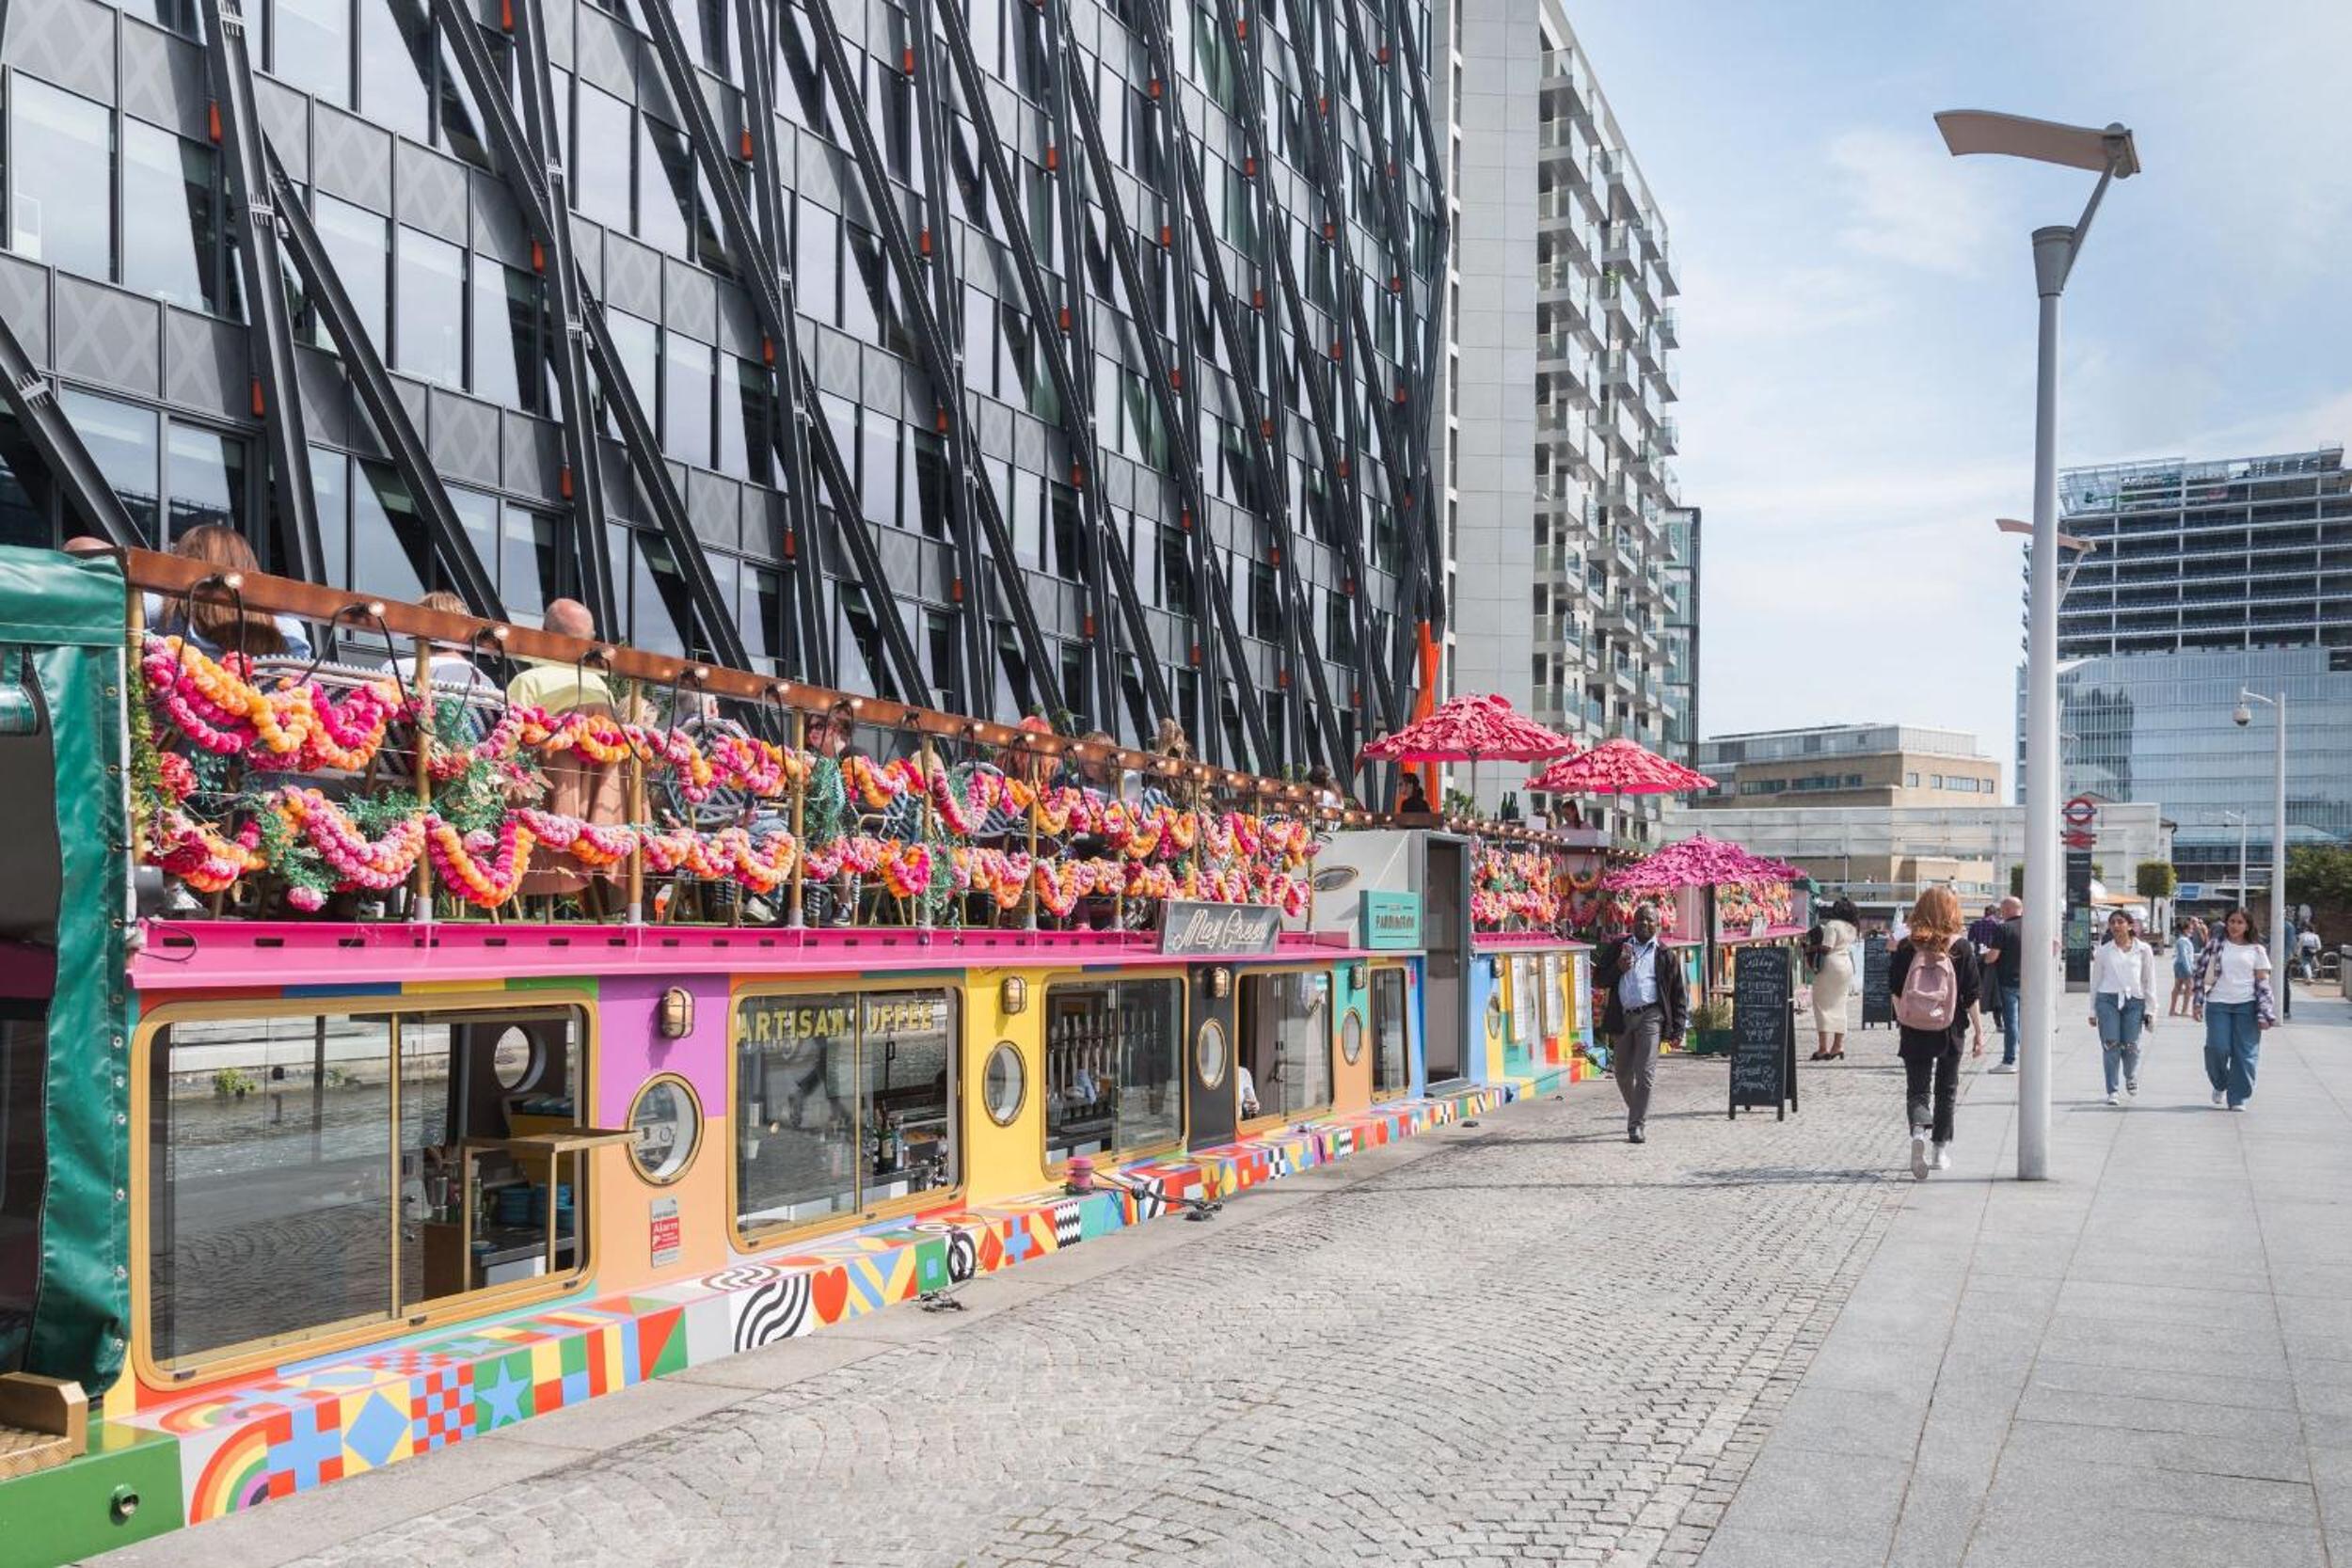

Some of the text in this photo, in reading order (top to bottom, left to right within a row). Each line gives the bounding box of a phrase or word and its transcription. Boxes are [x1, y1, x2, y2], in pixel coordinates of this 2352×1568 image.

[1172, 908, 1268, 951] May Green
[737, 1007, 846, 1041] ARTISAN
